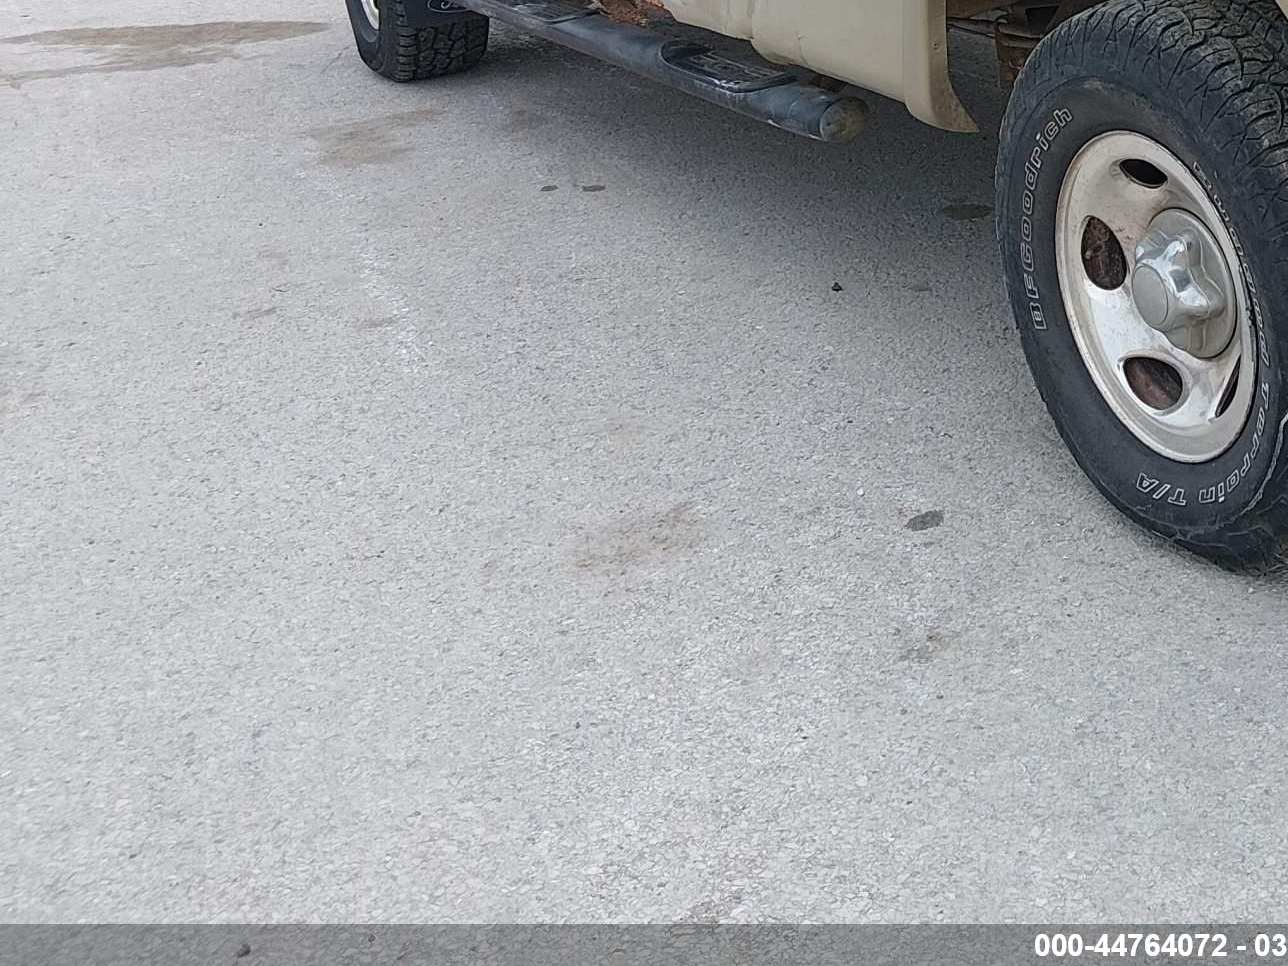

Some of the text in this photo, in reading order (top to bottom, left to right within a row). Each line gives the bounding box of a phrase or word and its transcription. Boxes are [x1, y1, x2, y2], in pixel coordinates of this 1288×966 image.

[1020, 107, 1074, 330] BFGoodrich
[1136, 472, 1187, 506] T/A
[1198, 382, 1270, 503] Terrain
